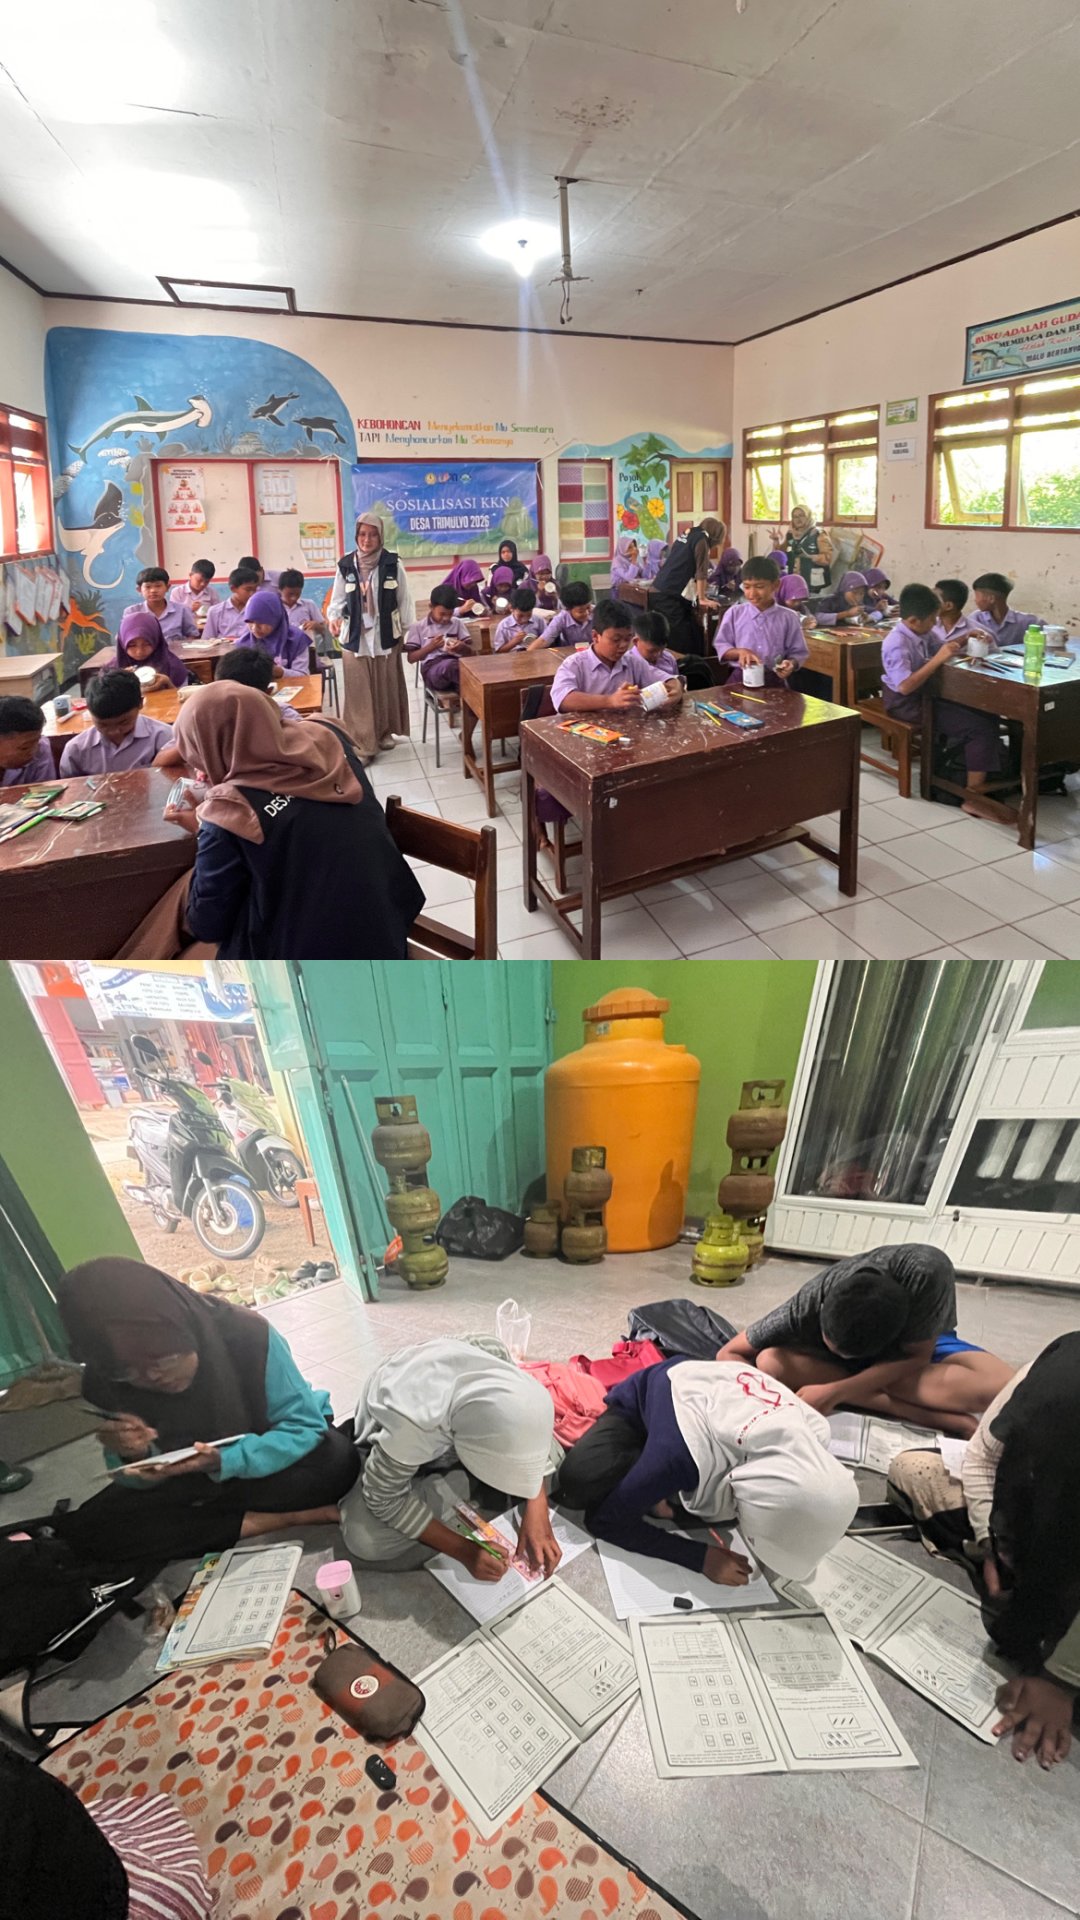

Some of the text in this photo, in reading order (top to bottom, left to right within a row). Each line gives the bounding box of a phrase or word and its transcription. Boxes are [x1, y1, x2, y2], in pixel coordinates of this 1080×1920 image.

[975, 331, 1002, 345] BUKU
[1002, 320, 1048, 338] ADALAH
[999, 333, 1043, 348] MEMBACA
[1046, 327, 1066, 338] DAN
[1026, 352, 1045, 362] MALU
[357, 418, 421, 431] KEBOHONGAN
[511, 423, 554, 434] Sementara
[359, 432, 380, 443] TAPI
[385, 433, 453, 446] Menghancurkan
[386, 496, 510, 512] SOSIALISASI KKN
[409, 514, 490, 531] DESA TRIMULYO 2026
